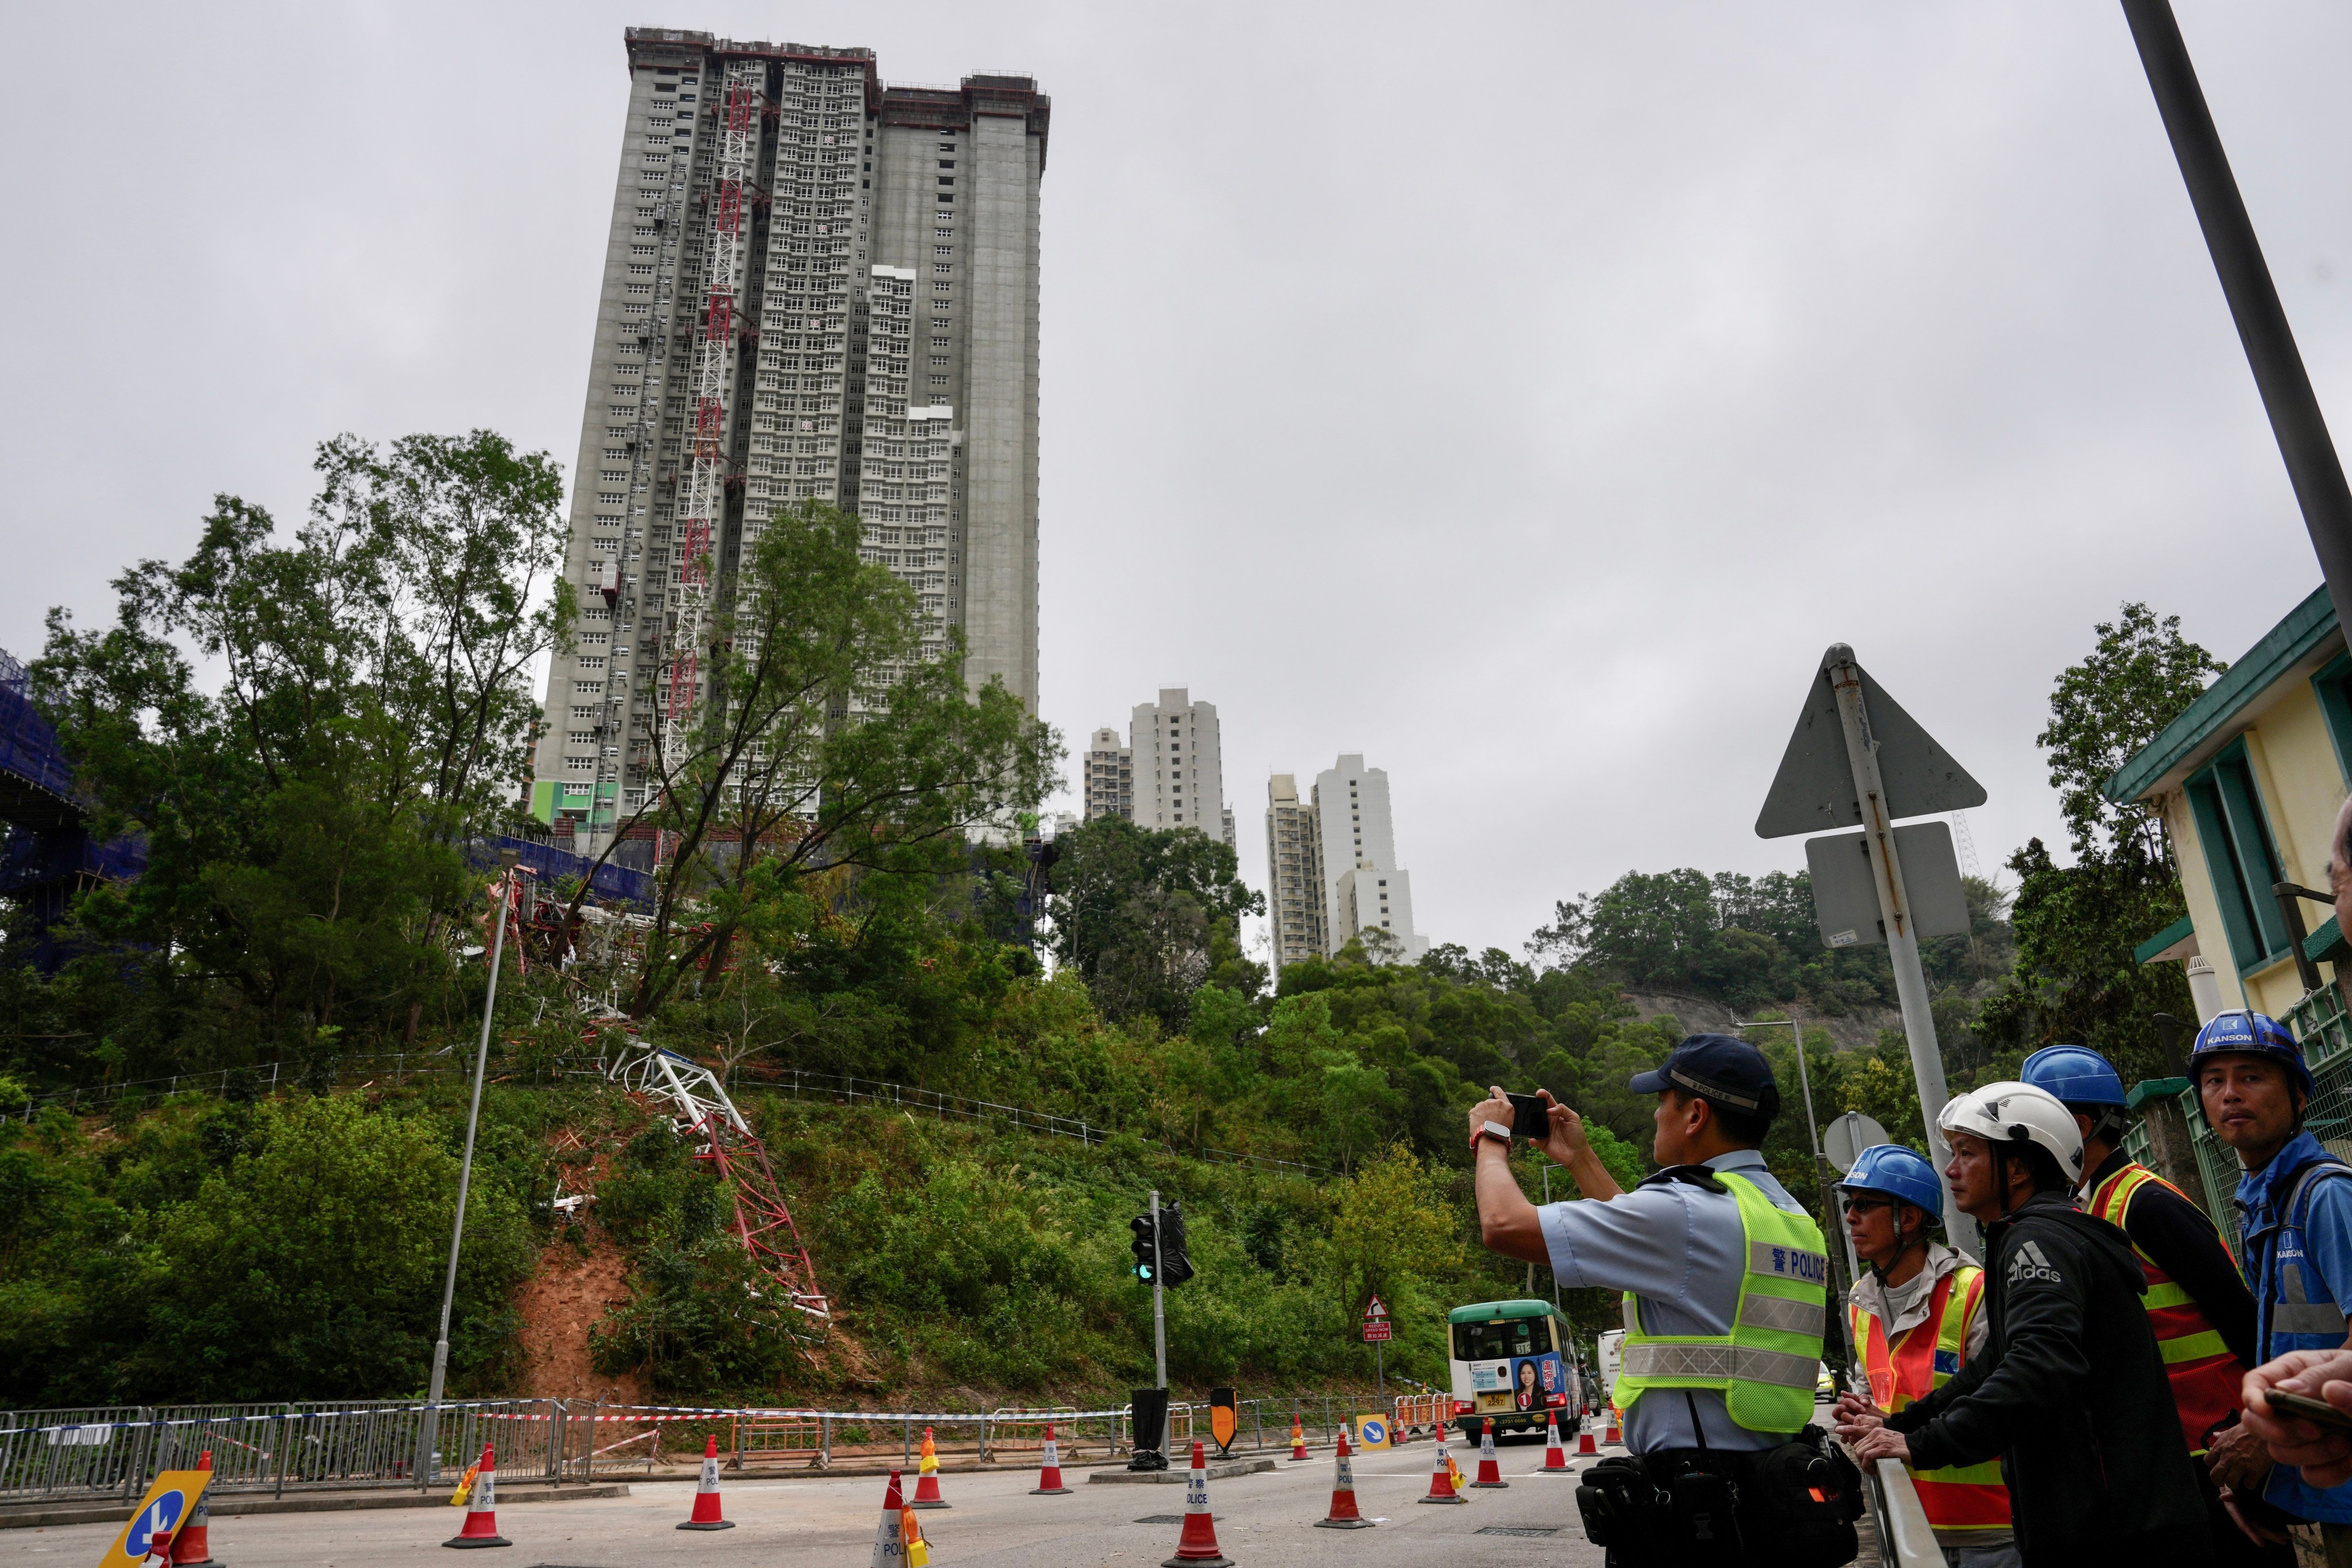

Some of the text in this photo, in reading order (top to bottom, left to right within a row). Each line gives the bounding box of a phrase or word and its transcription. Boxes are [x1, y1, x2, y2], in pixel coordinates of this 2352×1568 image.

[2207, 1034, 2252, 1044] KANSON
[1698, 1085, 1723, 1098] POLICE
[2277, 1249, 2304, 1258] KANSON
[1772, 1248, 1824, 1280] 警 POLICE
[1517, 1345, 1532, 1354] 313
[1521, 1394, 1527, 1405] 1
[888, 1524, 899, 1538] 警
